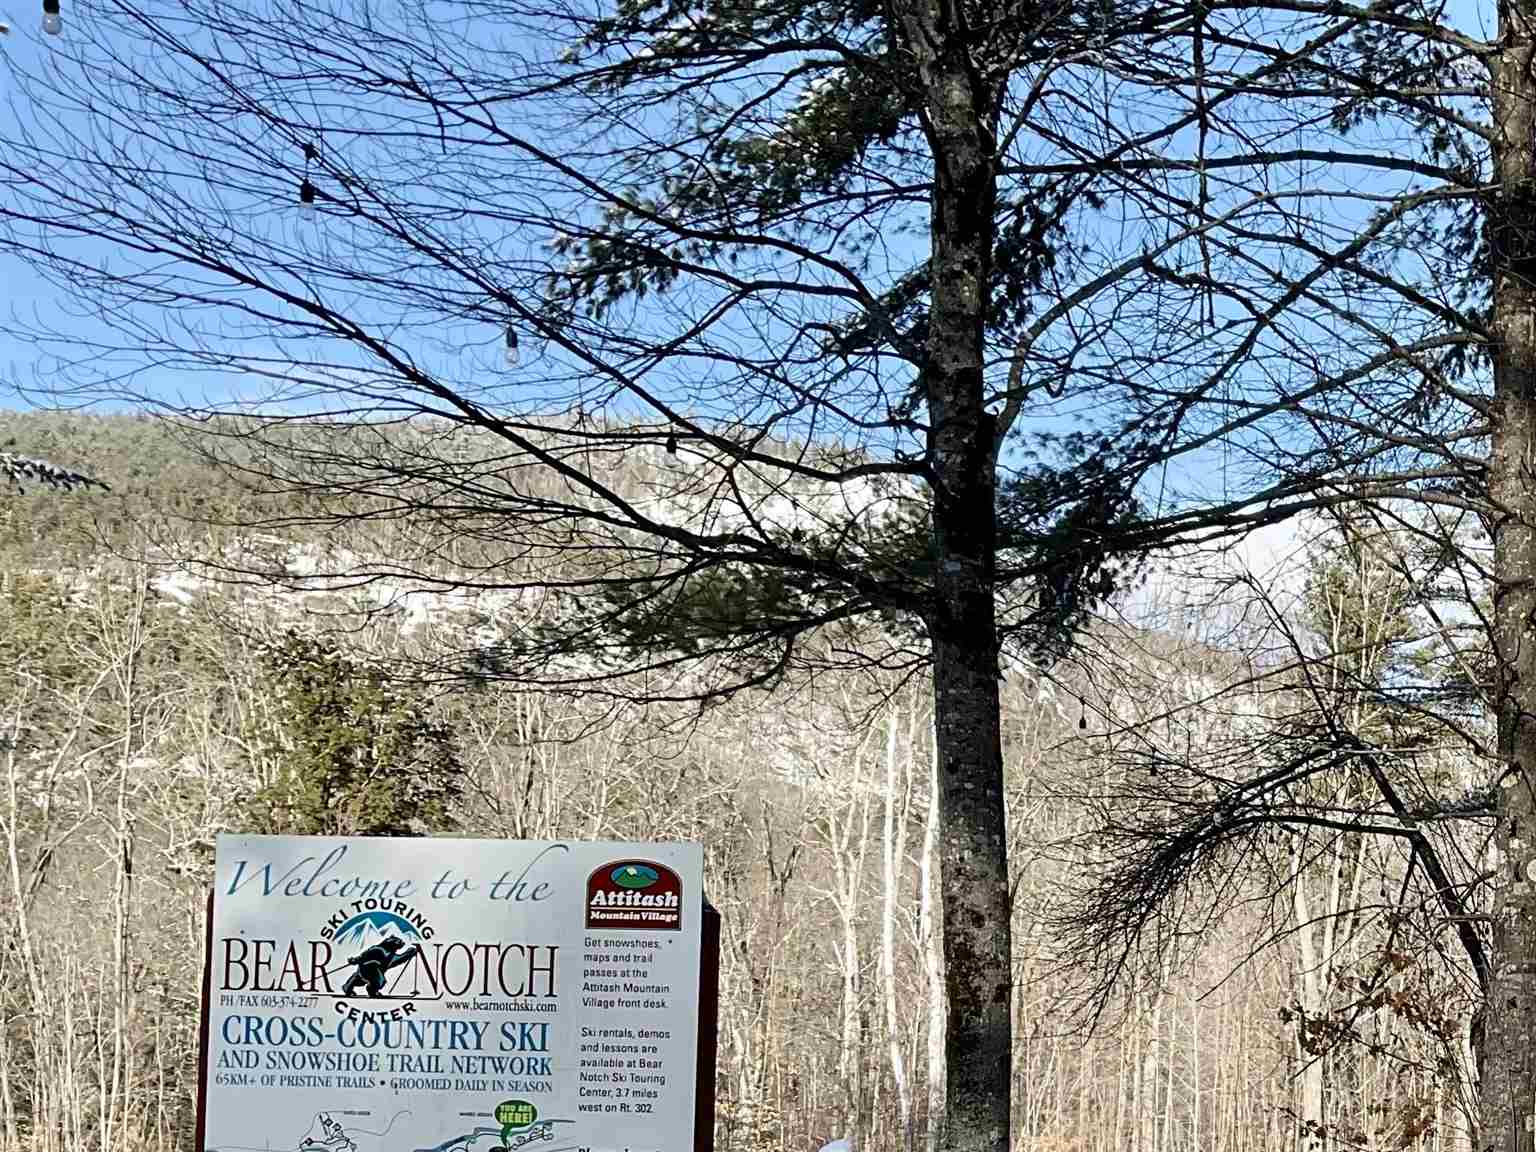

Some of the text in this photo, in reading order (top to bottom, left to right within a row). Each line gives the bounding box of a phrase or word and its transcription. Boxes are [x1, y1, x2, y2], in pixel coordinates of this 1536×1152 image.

[226, 844, 569, 901] Welcome to the
[590, 889, 678, 907] Attitash
[320, 898, 435, 940] SKI TOURING
[590, 910, 678, 922] Mountain Village
[584, 937, 602, 947] Get
[584, 952, 653, 963] maps and trail
[220, 938, 560, 998] BEAR NOTCH
[583, 967, 648, 978] passes at the
[582, 982, 670, 993] Attitash Mountain
[445, 998, 557, 1013] www.bearnotchski.com
[582, 997, 669, 1009] Village front desk.
[335, 1001, 416, 1024] CENTER
[222, 1014, 550, 1052] CROSS-COUNTRY SKI
[581, 1026, 671, 1039] Ski rentals, demos
[580, 1042, 658, 1053] and lessons are
[217, 1050, 553, 1076] AND SNOWSHOE TRAIL NETWORK
[580, 1058, 663, 1069] available at Bear
[260, 1074, 276, 1086] OF
[280, 1074, 332, 1088] PRISTINE
[335, 1076, 376, 1088] TRAILS
[390, 1077, 451, 1090] GROOMED
[455, 1078, 488, 1091] DAILY
[492, 1079, 506, 1092] IN
[508, 1080, 553, 1093] SEASON
[579, 1071, 666, 1086] Notch Ski Touring
[579, 1086, 614, 1098] Center,
[632, 1088, 658, 1098] miles
[499, 1104, 516, 1112] YOU
[578, 1103, 602, 1112] west
[605, 1104, 617, 1112] on
[620, 1103, 632, 1112] Rt.
[499, 1112, 533, 1124] HERE!
